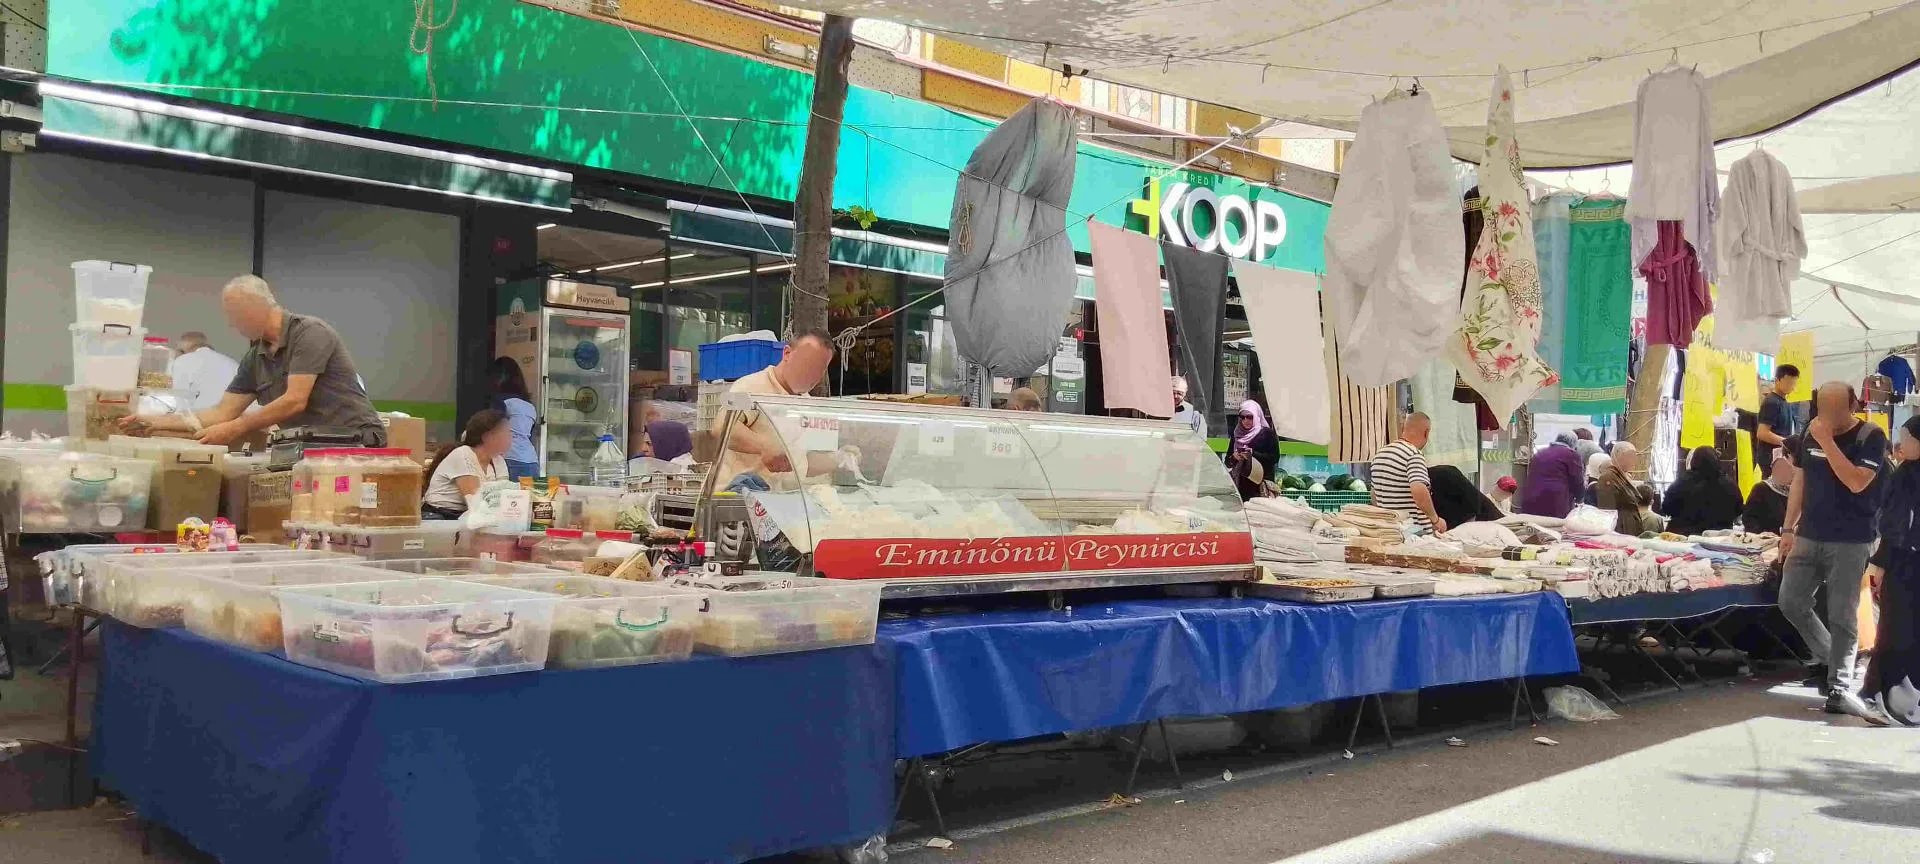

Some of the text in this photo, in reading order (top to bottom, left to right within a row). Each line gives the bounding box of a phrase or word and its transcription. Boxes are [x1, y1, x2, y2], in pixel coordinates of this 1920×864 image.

[1150, 180, 1287, 262] KOOP
[875, 535, 1219, 567] Eminönü Peynircisi
